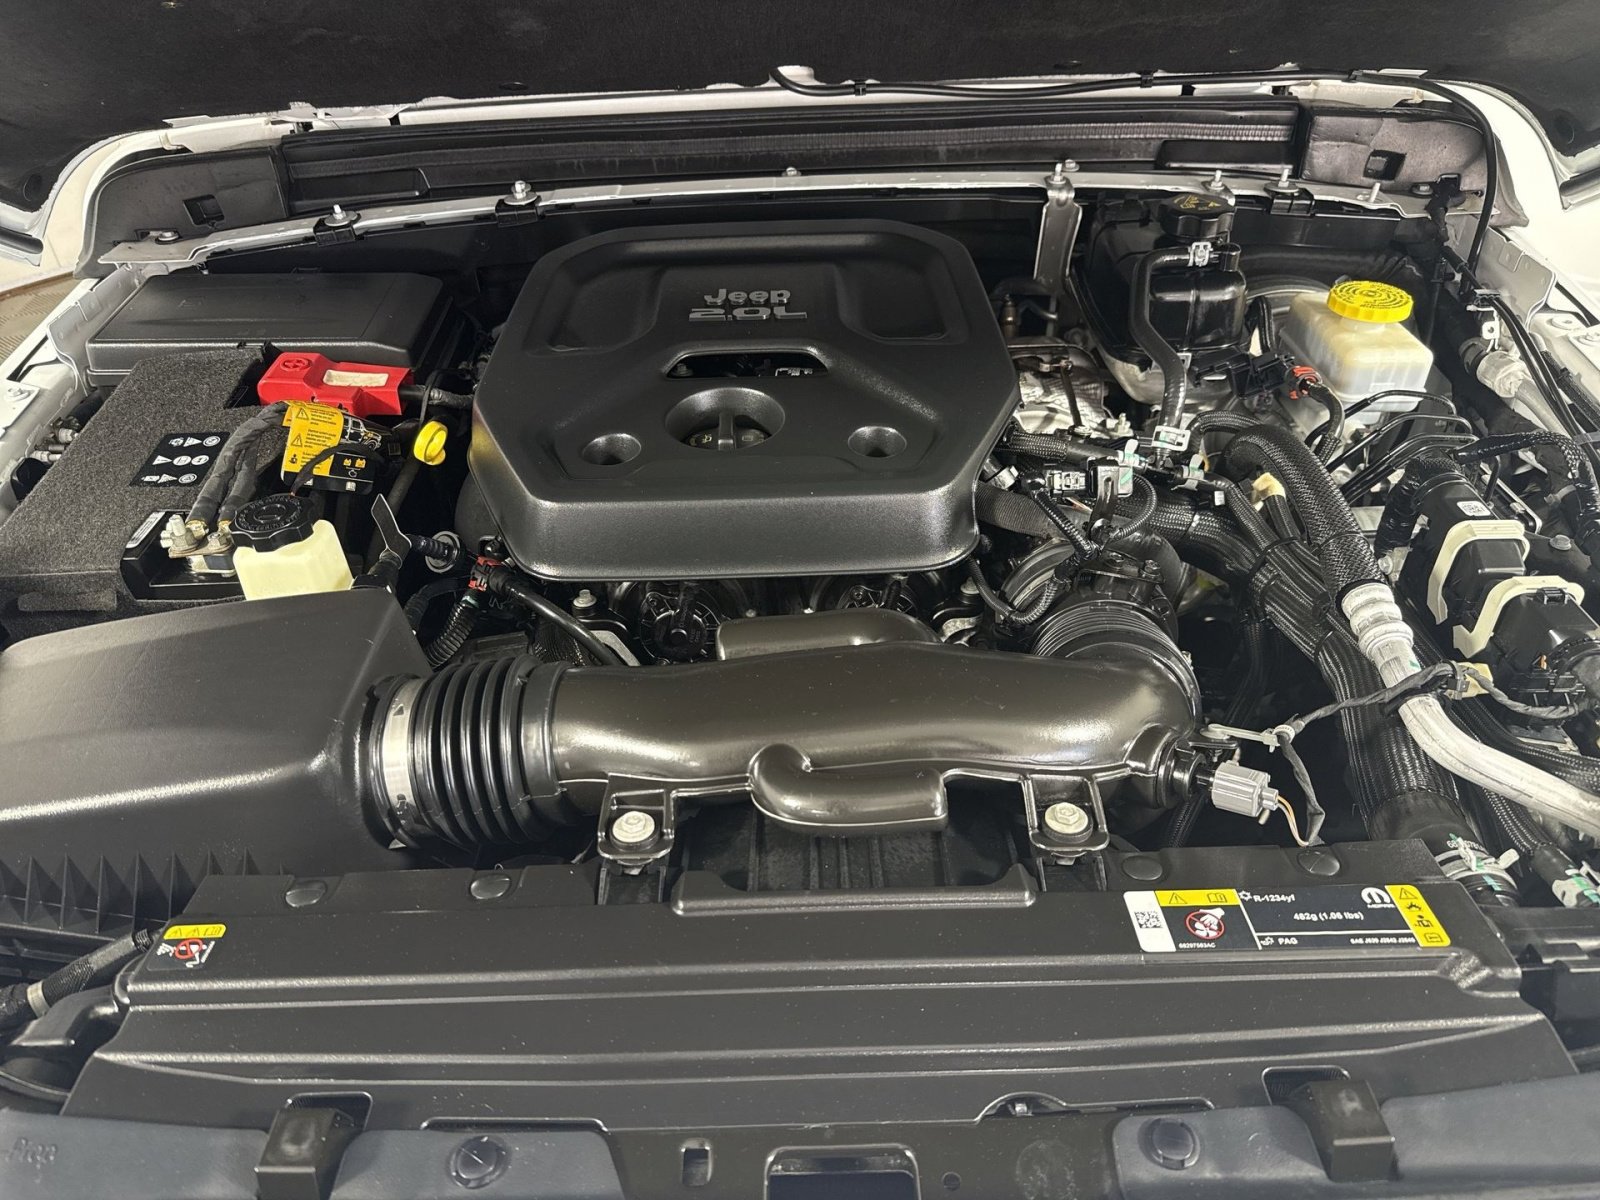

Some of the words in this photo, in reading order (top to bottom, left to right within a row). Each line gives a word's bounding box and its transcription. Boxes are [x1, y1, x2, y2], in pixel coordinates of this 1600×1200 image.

[703, 287, 791, 305] Jeep
[688, 305, 808, 321] 2.0L
[1293, 911, 1318, 922] 482g
[1343, 911, 1365, 921] lbs)
[1277, 936, 1299, 945] PAG
